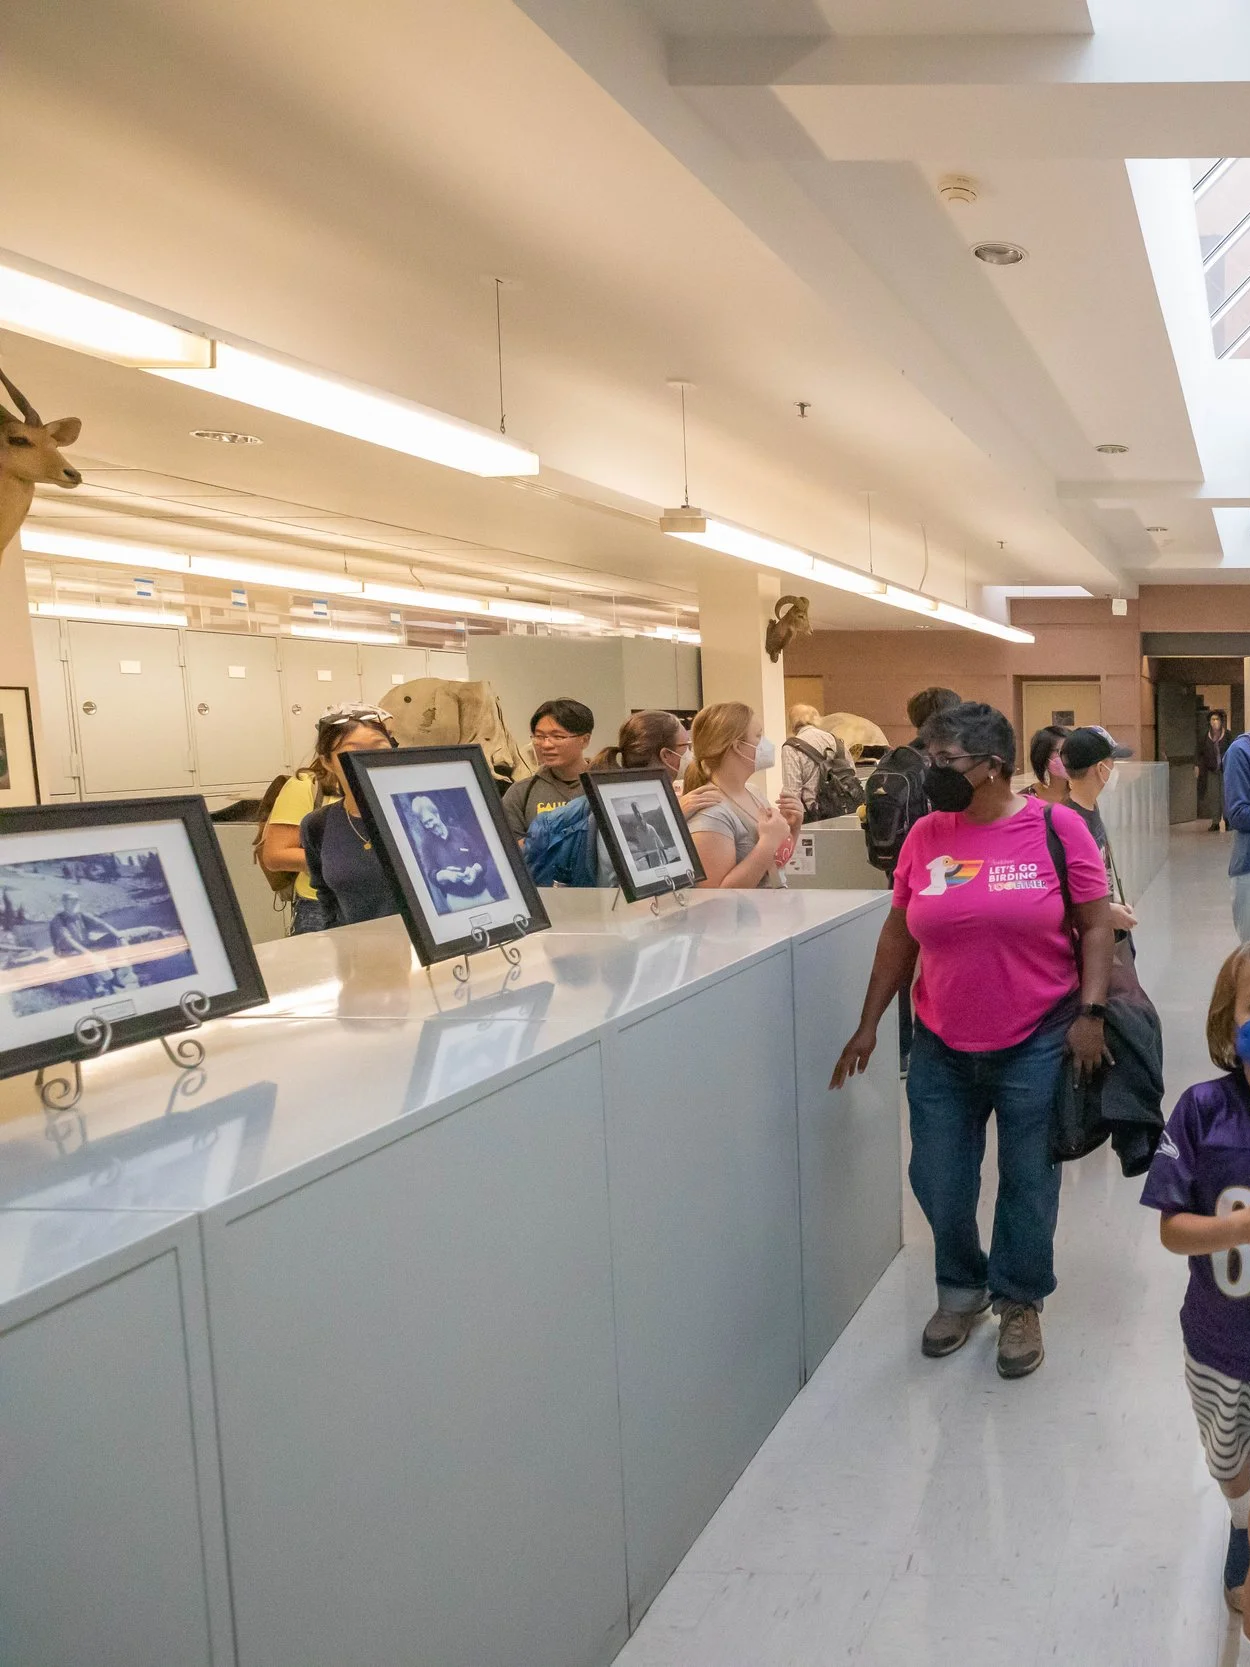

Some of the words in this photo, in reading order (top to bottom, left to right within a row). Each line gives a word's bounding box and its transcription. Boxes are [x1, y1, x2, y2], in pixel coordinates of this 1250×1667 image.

[988, 864, 1016, 875] LET'S
[1018, 863, 1038, 872] GO
[988, 872, 1038, 883] BIRDING
